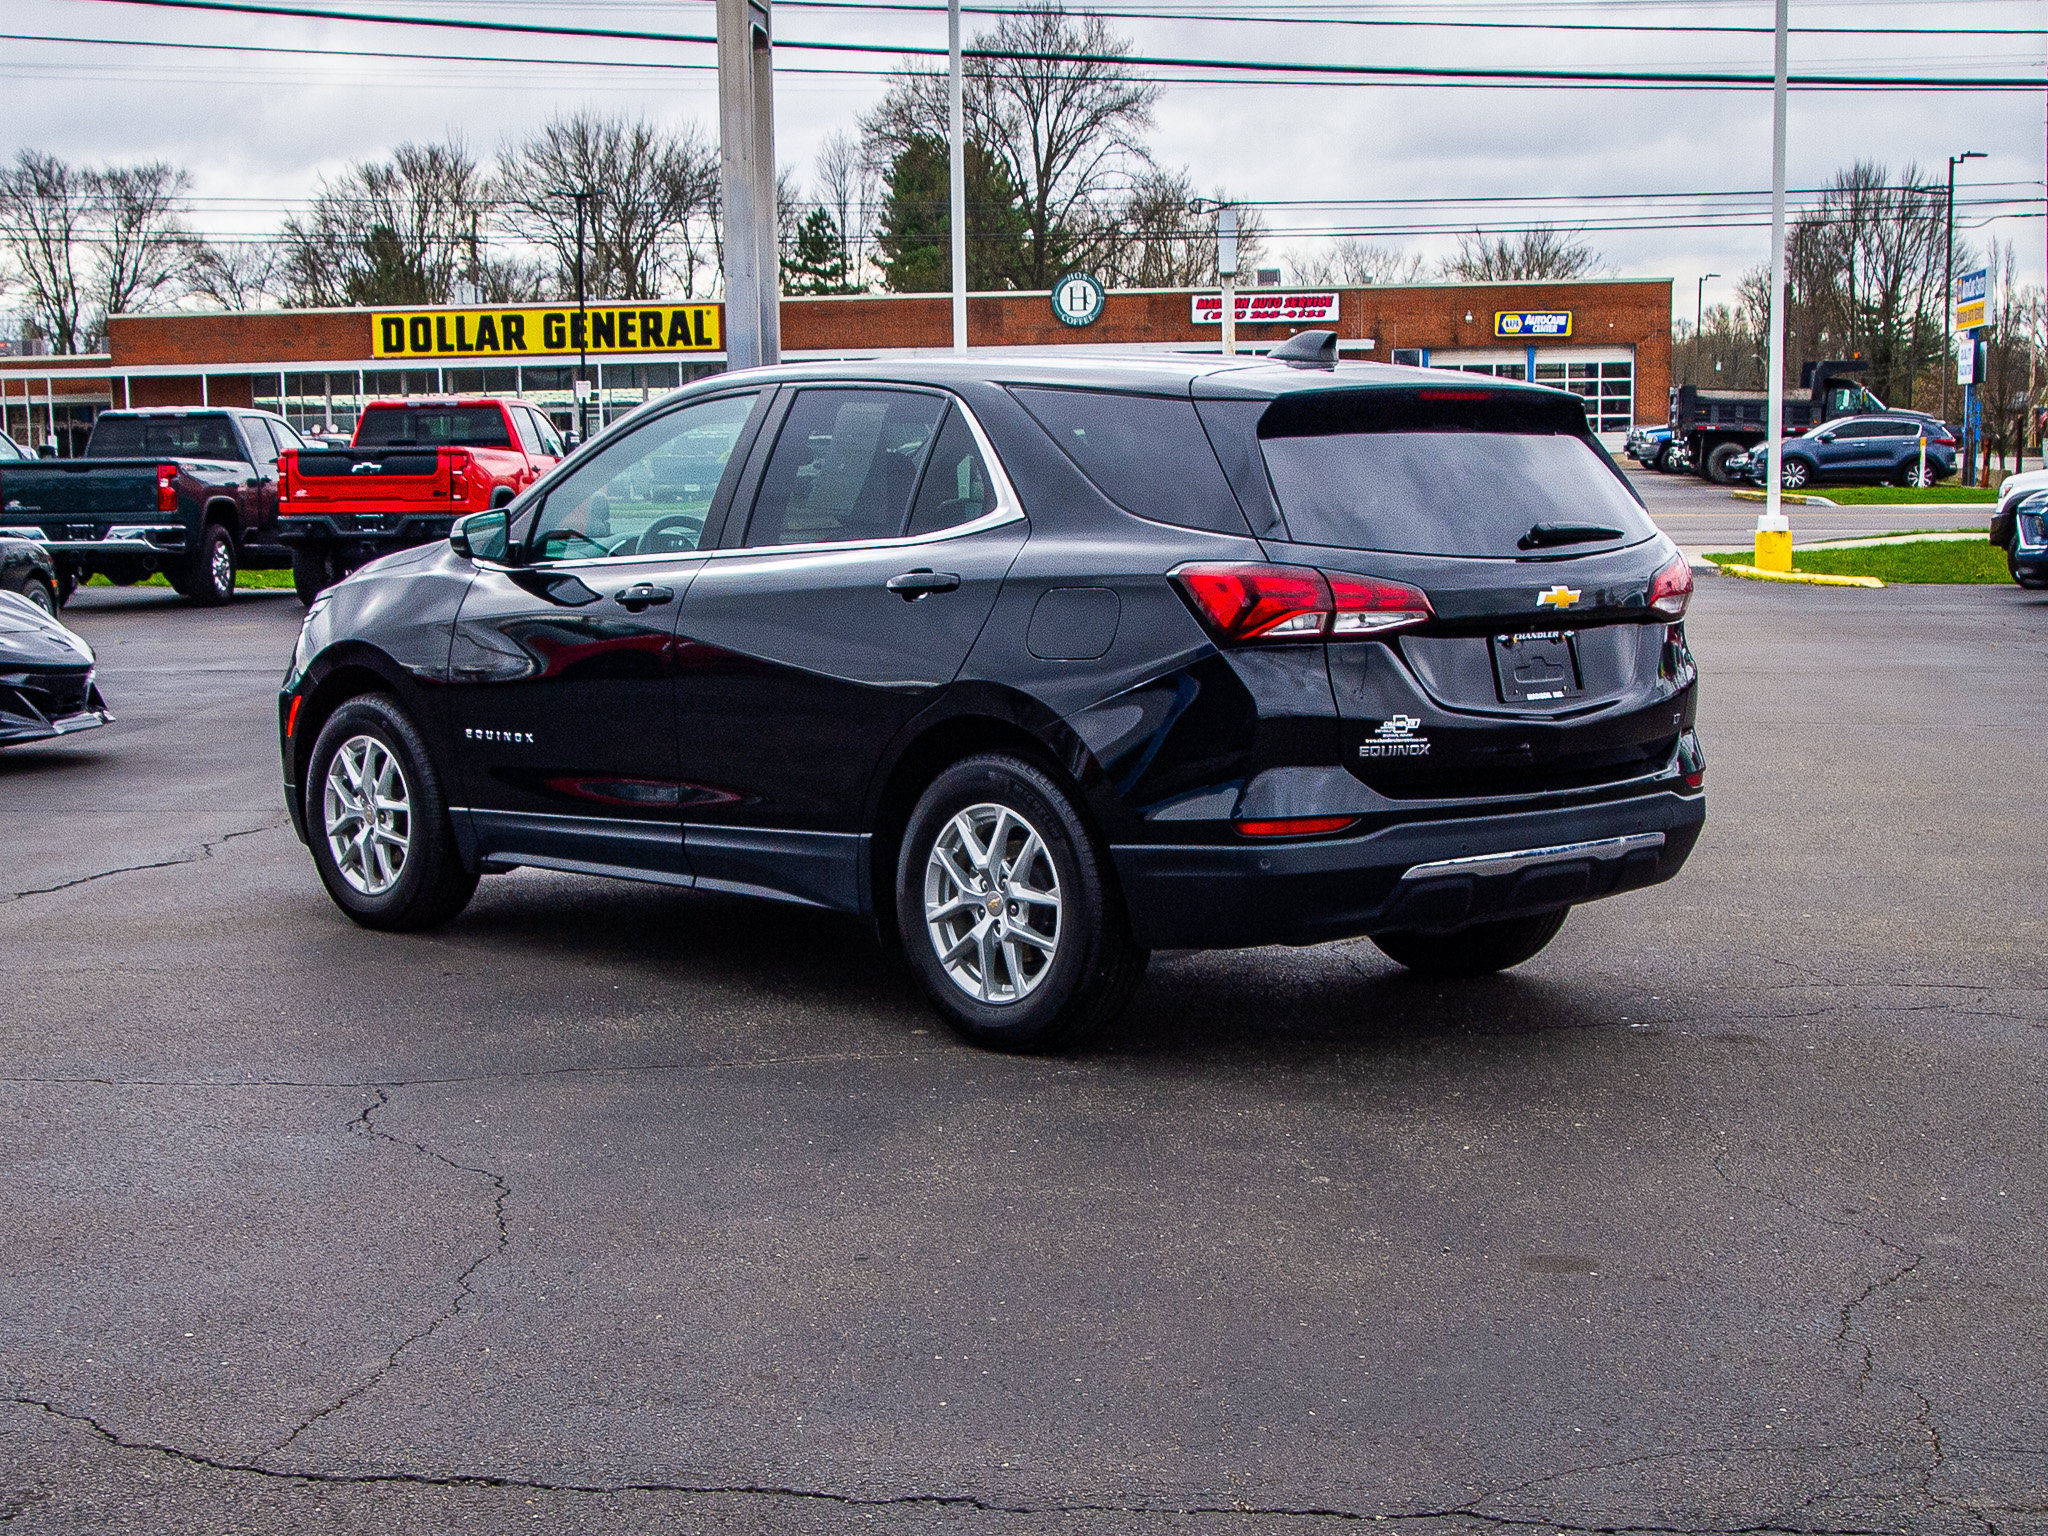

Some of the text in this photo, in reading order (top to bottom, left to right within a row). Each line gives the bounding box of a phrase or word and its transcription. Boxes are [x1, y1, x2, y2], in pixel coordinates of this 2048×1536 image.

[1251, 296, 1283, 309] AUTO
[1284, 295, 1334, 308] SERVICE
[1061, 314, 1095, 326] COFFEE
[381, 309, 713, 353] DOLLAR GENERAL
[1514, 631, 1559, 640] CHANDLER
[465, 728, 534, 743] EQUINOX
[1359, 743, 1431, 757] EQUINOX
